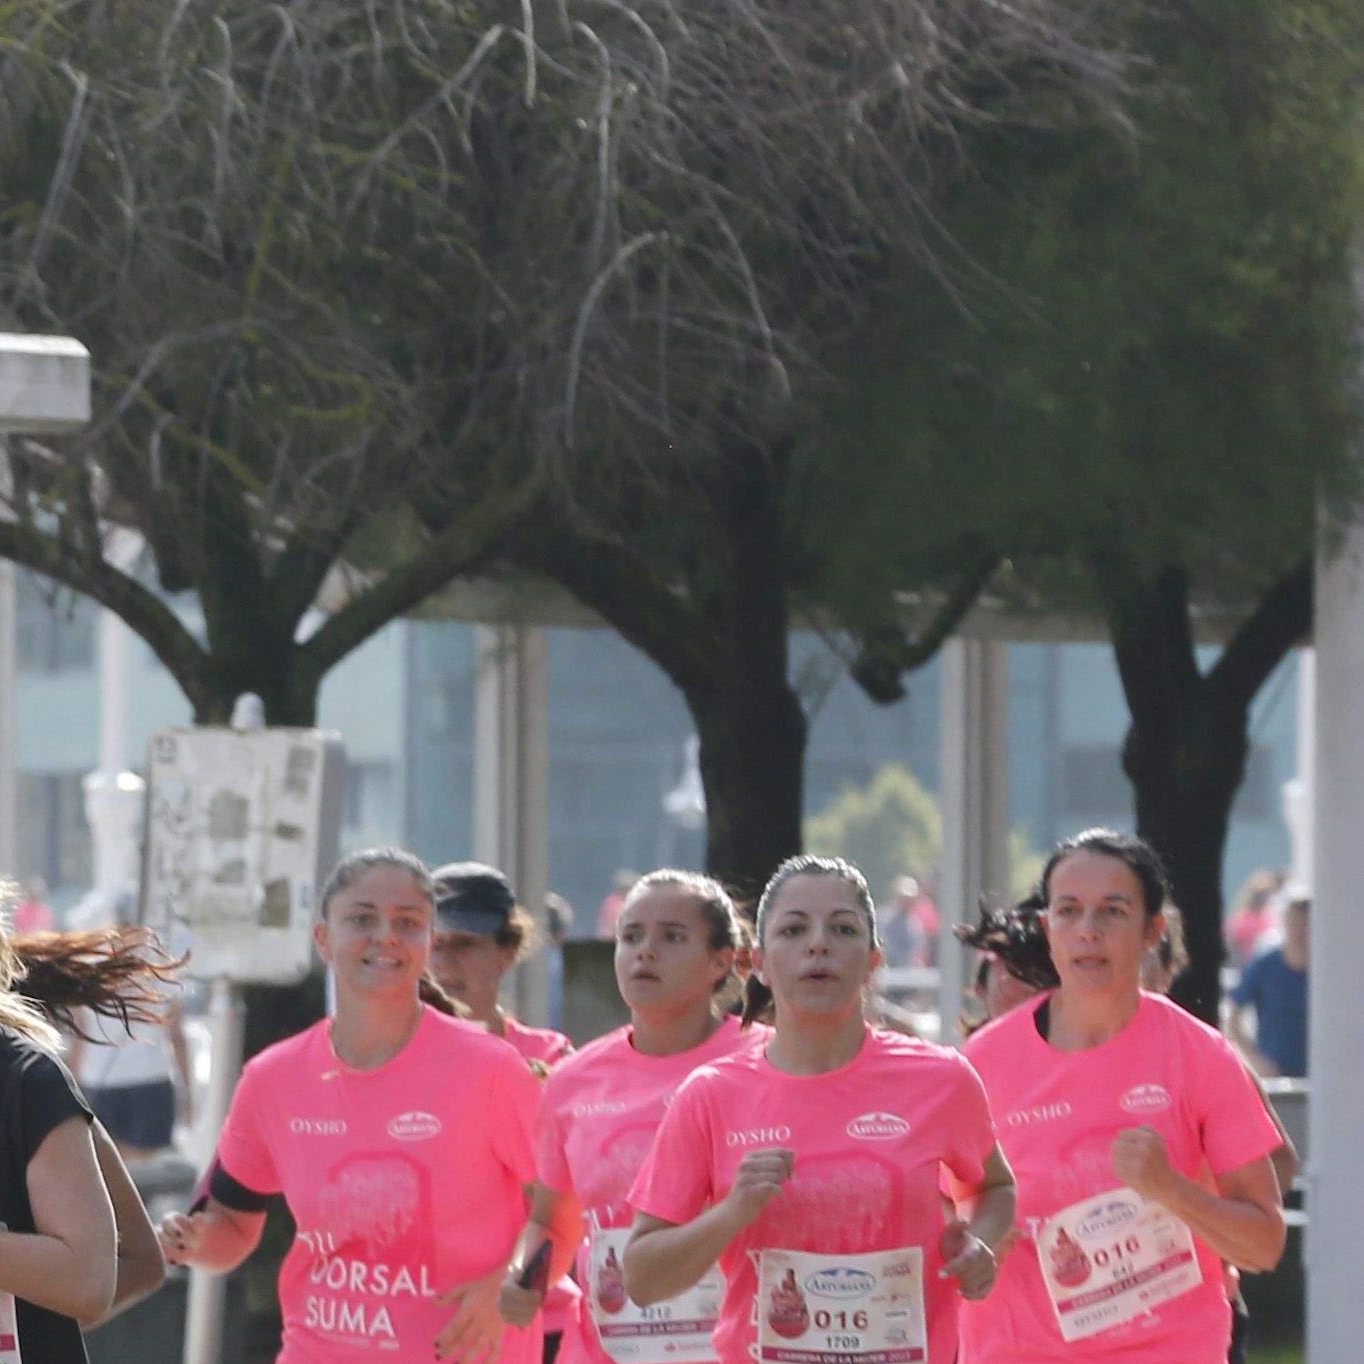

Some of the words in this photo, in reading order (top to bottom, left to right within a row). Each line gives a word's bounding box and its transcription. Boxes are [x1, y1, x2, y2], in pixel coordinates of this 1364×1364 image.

[1006, 1100, 1072, 1126] OYSHO
[290, 1117, 348, 1136] OYSHO
[726, 1124, 792, 1147] OYSHO
[304, 1295, 396, 1338] SUMA
[814, 1309, 869, 1331] 016
